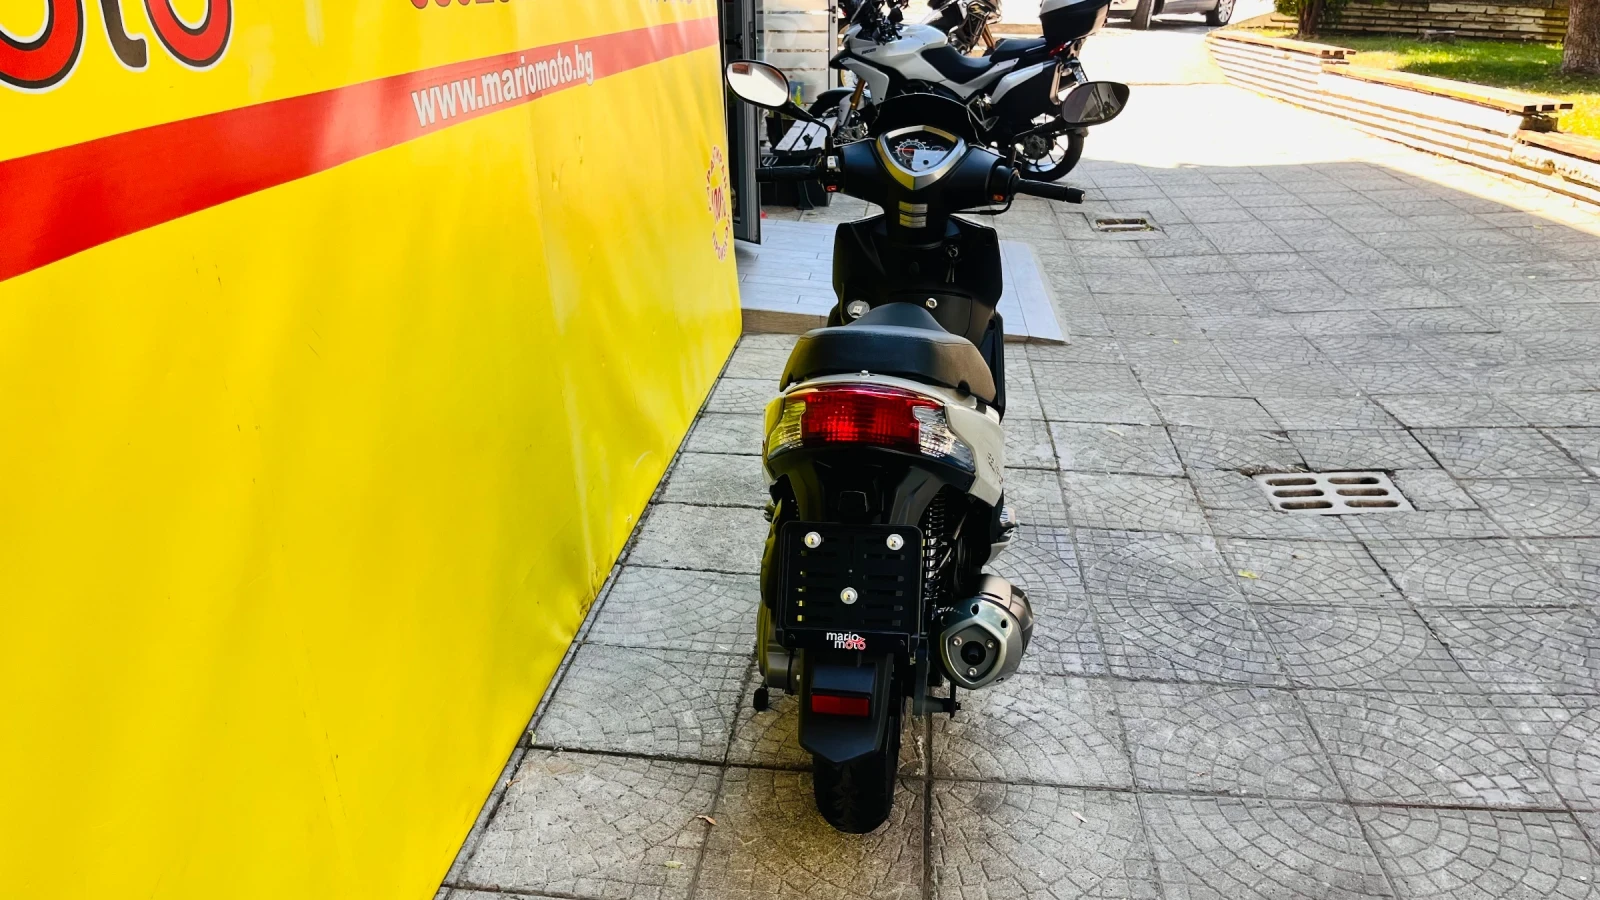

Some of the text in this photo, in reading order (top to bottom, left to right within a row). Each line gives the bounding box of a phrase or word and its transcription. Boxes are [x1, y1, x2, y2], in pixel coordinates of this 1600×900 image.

[411, 44, 594, 127] www.mariomoto.bg
[826, 631, 859, 641] mario
[834, 640, 866, 650] moto
